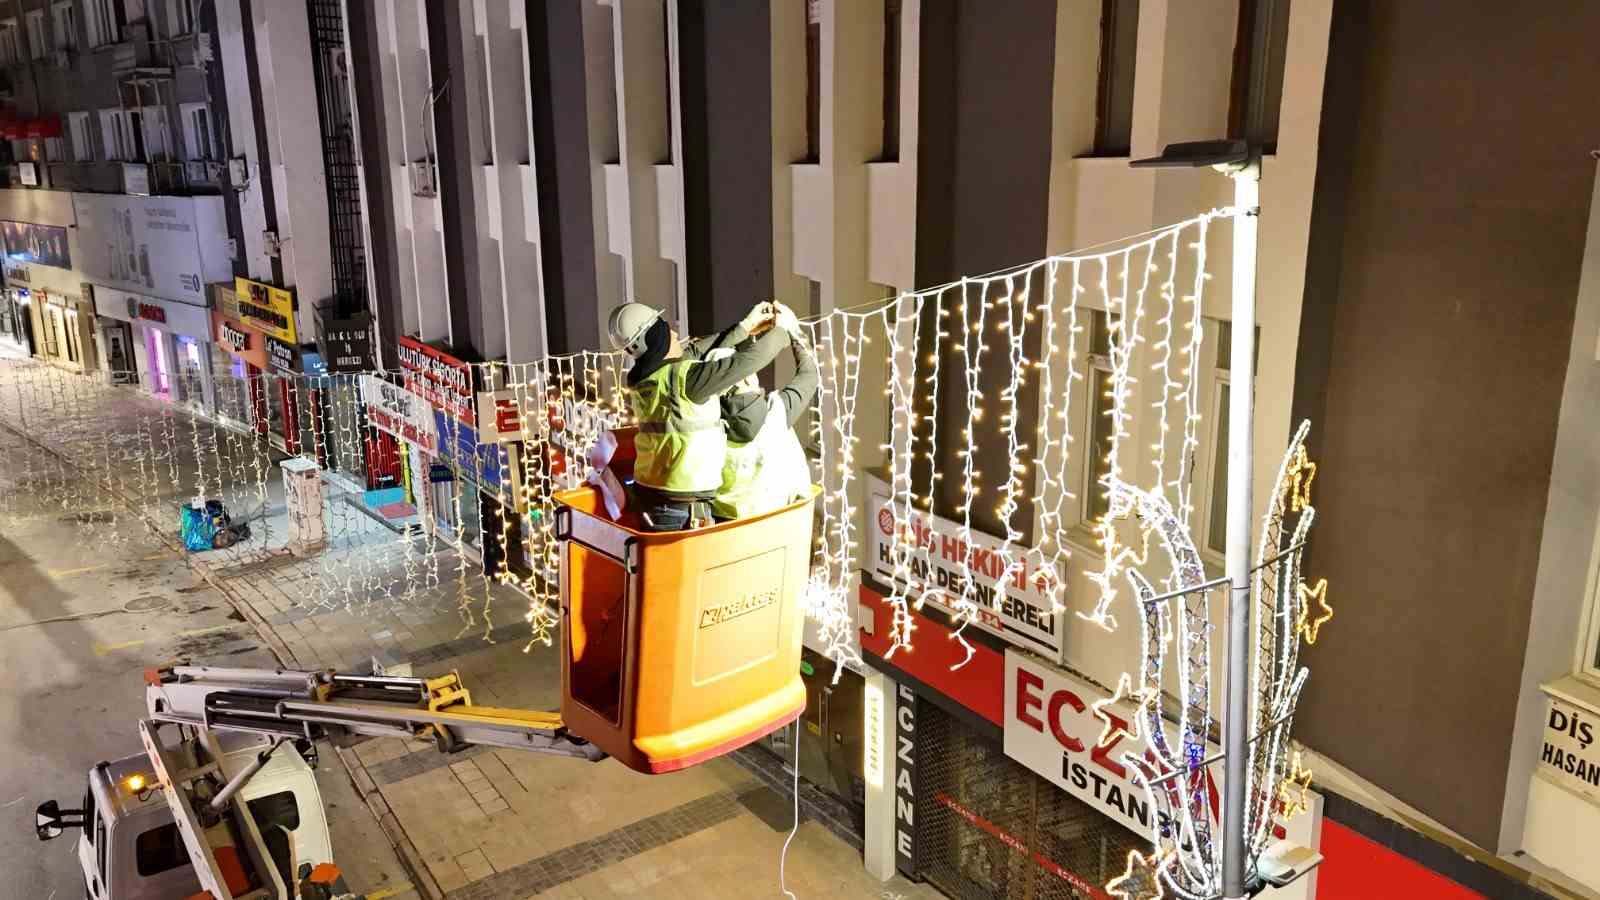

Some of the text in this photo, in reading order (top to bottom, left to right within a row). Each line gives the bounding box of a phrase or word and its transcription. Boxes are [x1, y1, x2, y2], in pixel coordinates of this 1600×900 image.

[398, 344, 467, 391] ULUTÜRK SİGORTA
[496, 399, 521, 432] E
[879, 542, 934, 585] HAN
[1549, 708, 1593, 750] DİŞ
[897, 684, 914, 858] ECZANE
[1542, 742, 1600, 786] HASAN
[1061, 752, 1210, 858] İSTANB
